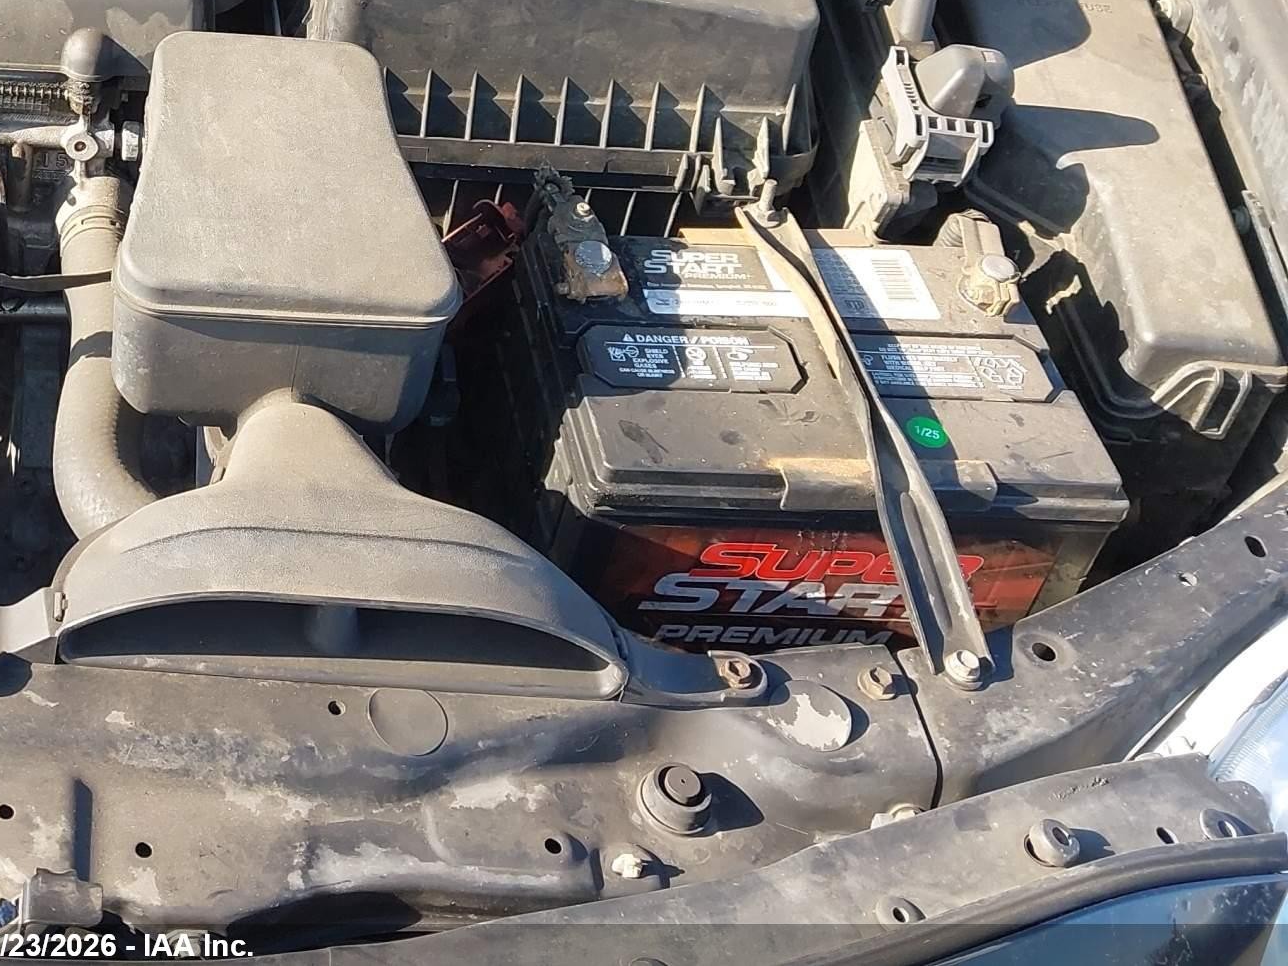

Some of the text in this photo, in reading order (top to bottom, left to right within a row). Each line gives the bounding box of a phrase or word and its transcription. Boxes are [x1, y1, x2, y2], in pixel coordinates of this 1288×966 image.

[651, 249, 740, 264] SUPER
[643, 260, 743, 275] START
[635, 333, 689, 345] DANGER
[914, 425, 940, 439] 1/25
[637, 573, 911, 617] STAR
[653, 624, 895, 646] PREMIUM
